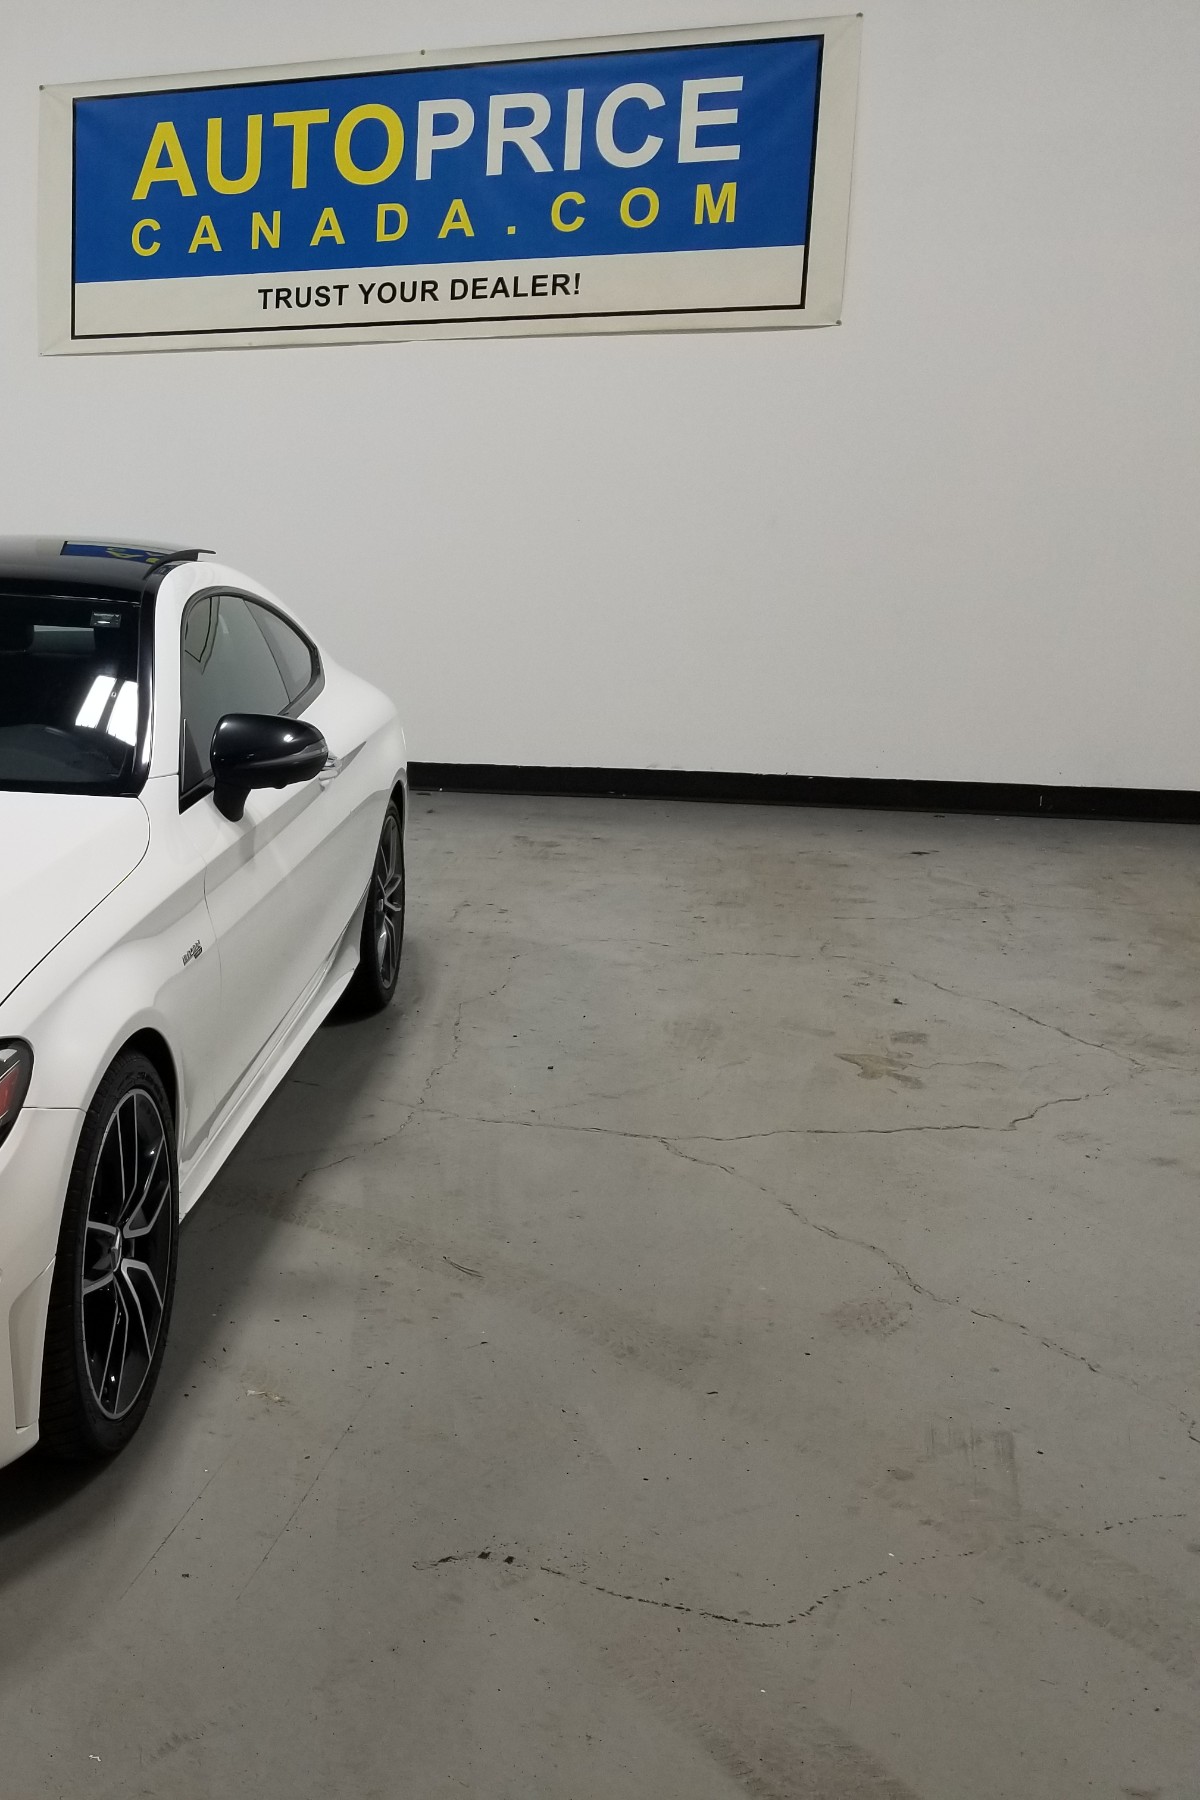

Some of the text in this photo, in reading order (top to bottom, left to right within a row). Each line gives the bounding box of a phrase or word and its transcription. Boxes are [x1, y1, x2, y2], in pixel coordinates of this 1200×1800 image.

[131, 76, 744, 201] AUTOPRICE
[257, 272, 581, 310] TRUST YOUR DEALER!
